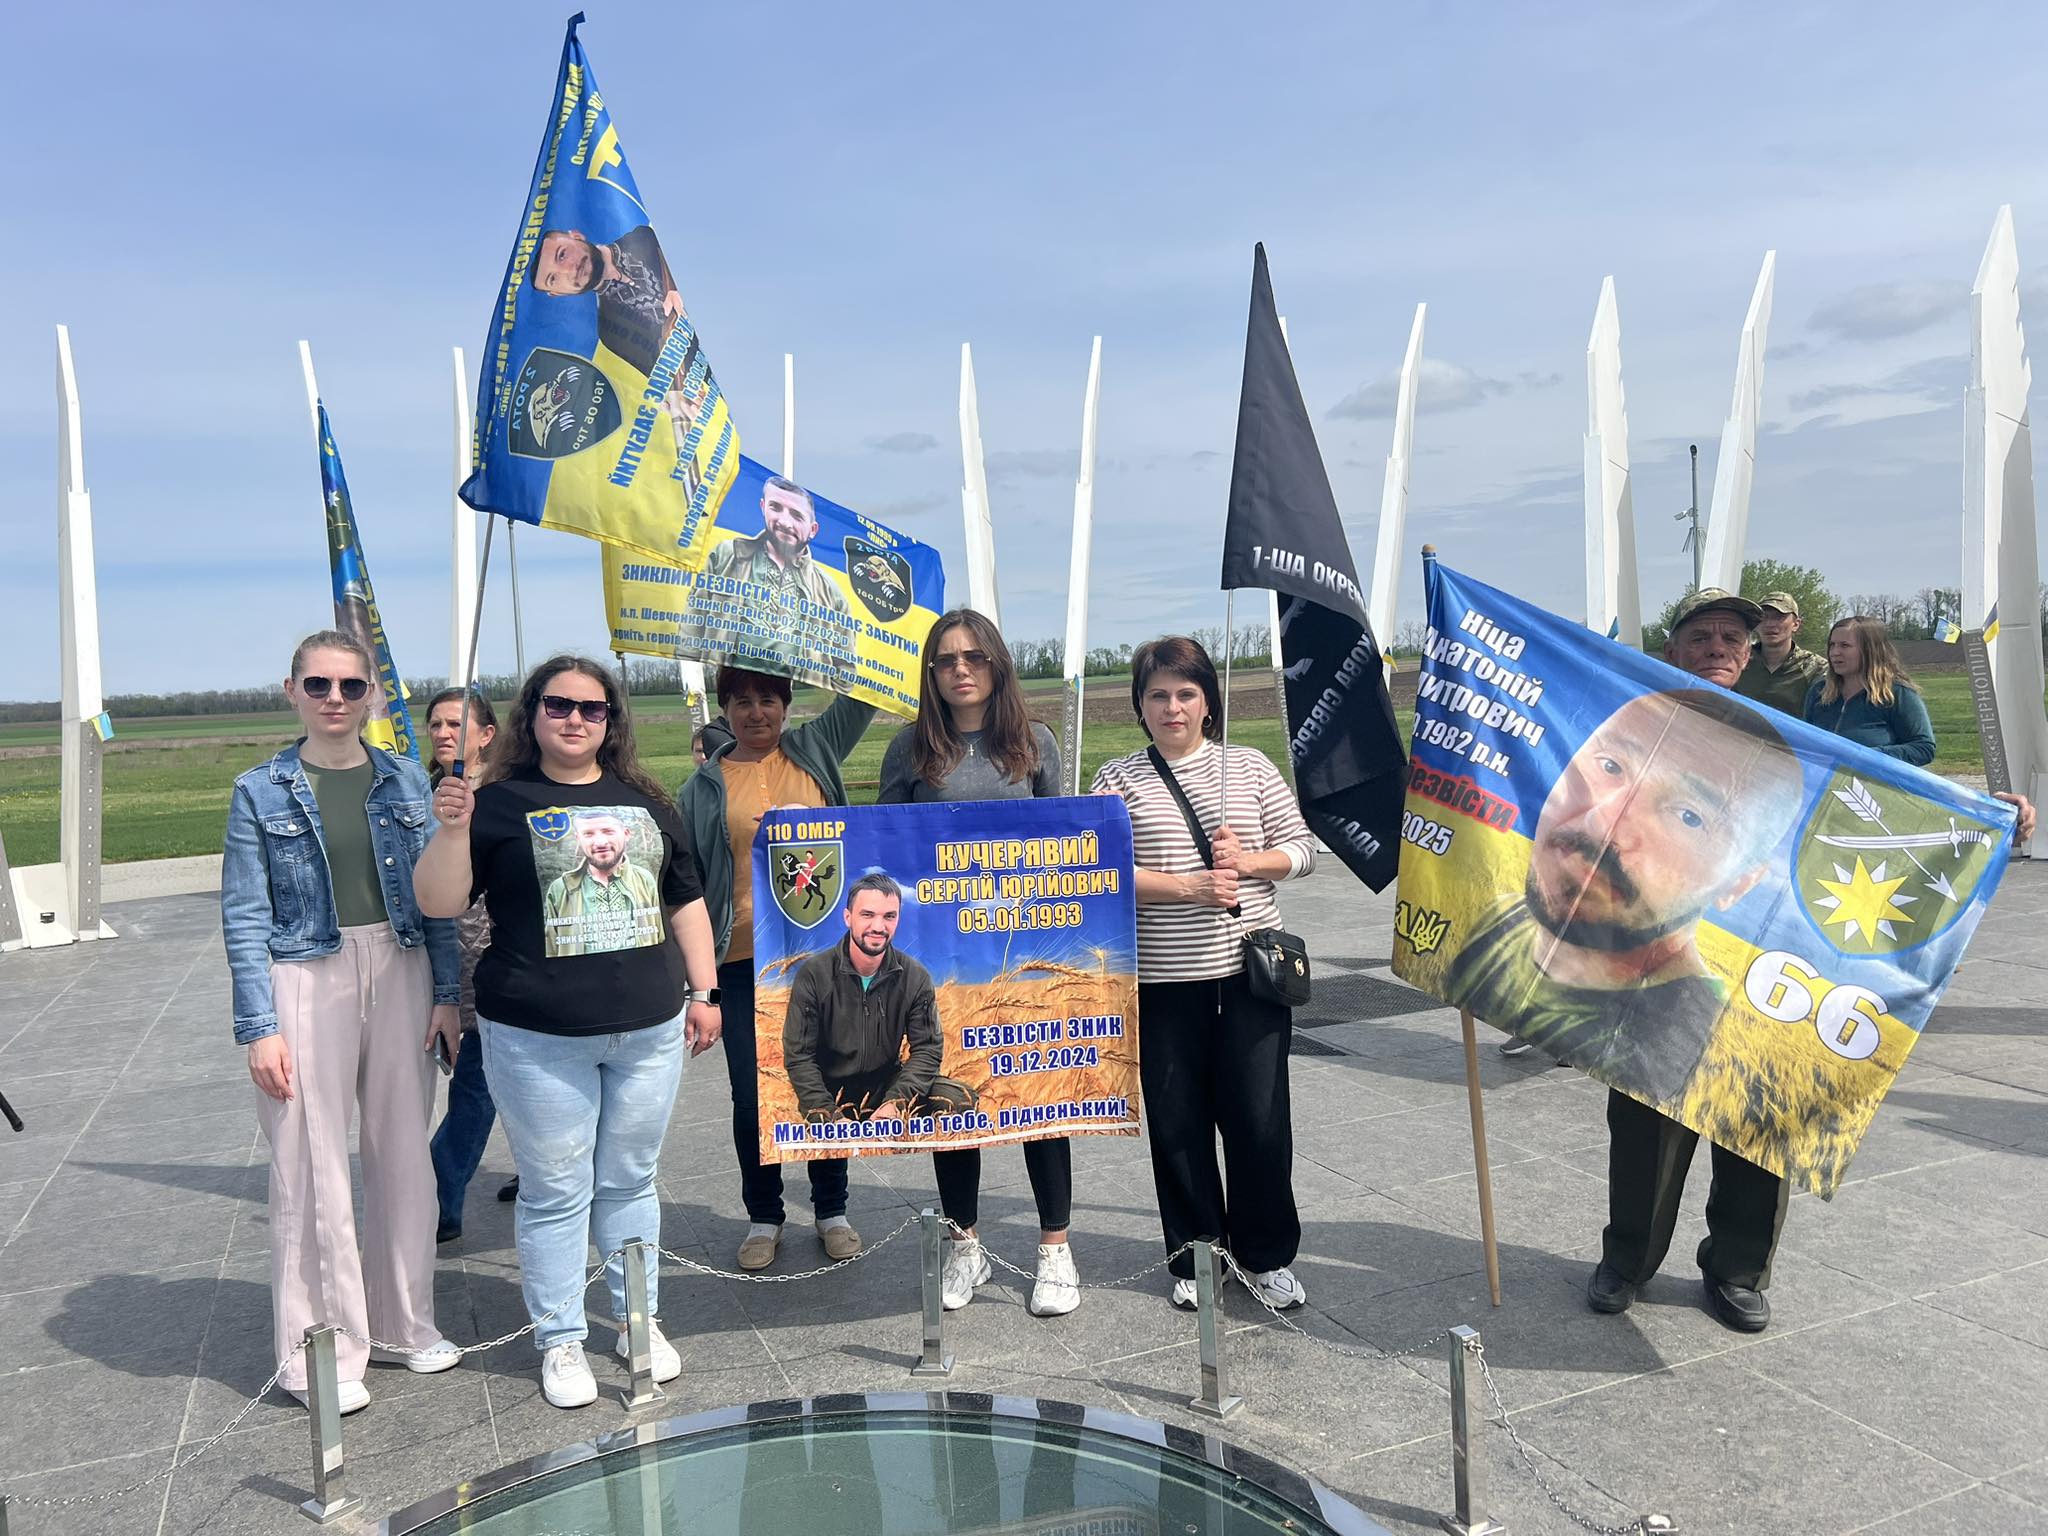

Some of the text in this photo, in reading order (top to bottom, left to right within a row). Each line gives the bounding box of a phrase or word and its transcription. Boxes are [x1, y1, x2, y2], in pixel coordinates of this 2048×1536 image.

[856, 543, 898, 565] 2 РОТА
[857, 588, 874, 600] 160
[1253, 546, 1368, 614] 1-ША ОКРЕ
[688, 596, 721, 611] Зник
[723, 600, 779, 624] безвісти
[696, 573, 771, 602] БЕЗВІСТИ
[779, 592, 796, 609] НЕ
[800, 599, 863, 632] ОЗНАЧАЄ
[866, 623, 919, 657] ЗАБУТИЙ
[641, 607, 704, 626] Шевченко
[706, 615, 801, 645] Волноваського
[814, 641, 863, 664] Донецьк
[866, 659, 904, 681] області
[1459, 608, 1526, 661] Ніца
[646, 632, 681, 645] героїв
[739, 642, 784, 664] Віримо,
[788, 655, 837, 677] любимо,
[840, 670, 895, 698] молимося,
[1423, 625, 1544, 708] Анатолій
[1968, 636, 1996, 733] ТЕРНОПІЛЬ
[1417, 671, 1545, 747] итрович
[1469, 741, 1510, 776] р.н.
[1408, 760, 1514, 829] езвісти
[765, 821, 846, 841] 110 ОМБР
[936, 830, 1099, 873] КУЧЕРЯВИЙ
[1400, 809, 1455, 856] 2025
[916, 869, 1120, 904] СЕРГІЙ ЮРІЙОВИЧ
[957, 904, 1083, 934] 05.01.1993
[1743, 949, 1890, 1062] 66
[962, 1014, 1123, 1050] БЕЗВІСТИ ЗНИК
[988, 1045, 1098, 1077] 19.12.2024
[774, 1098, 1128, 1144] Ми чекаємо на тебе, рідненький!
